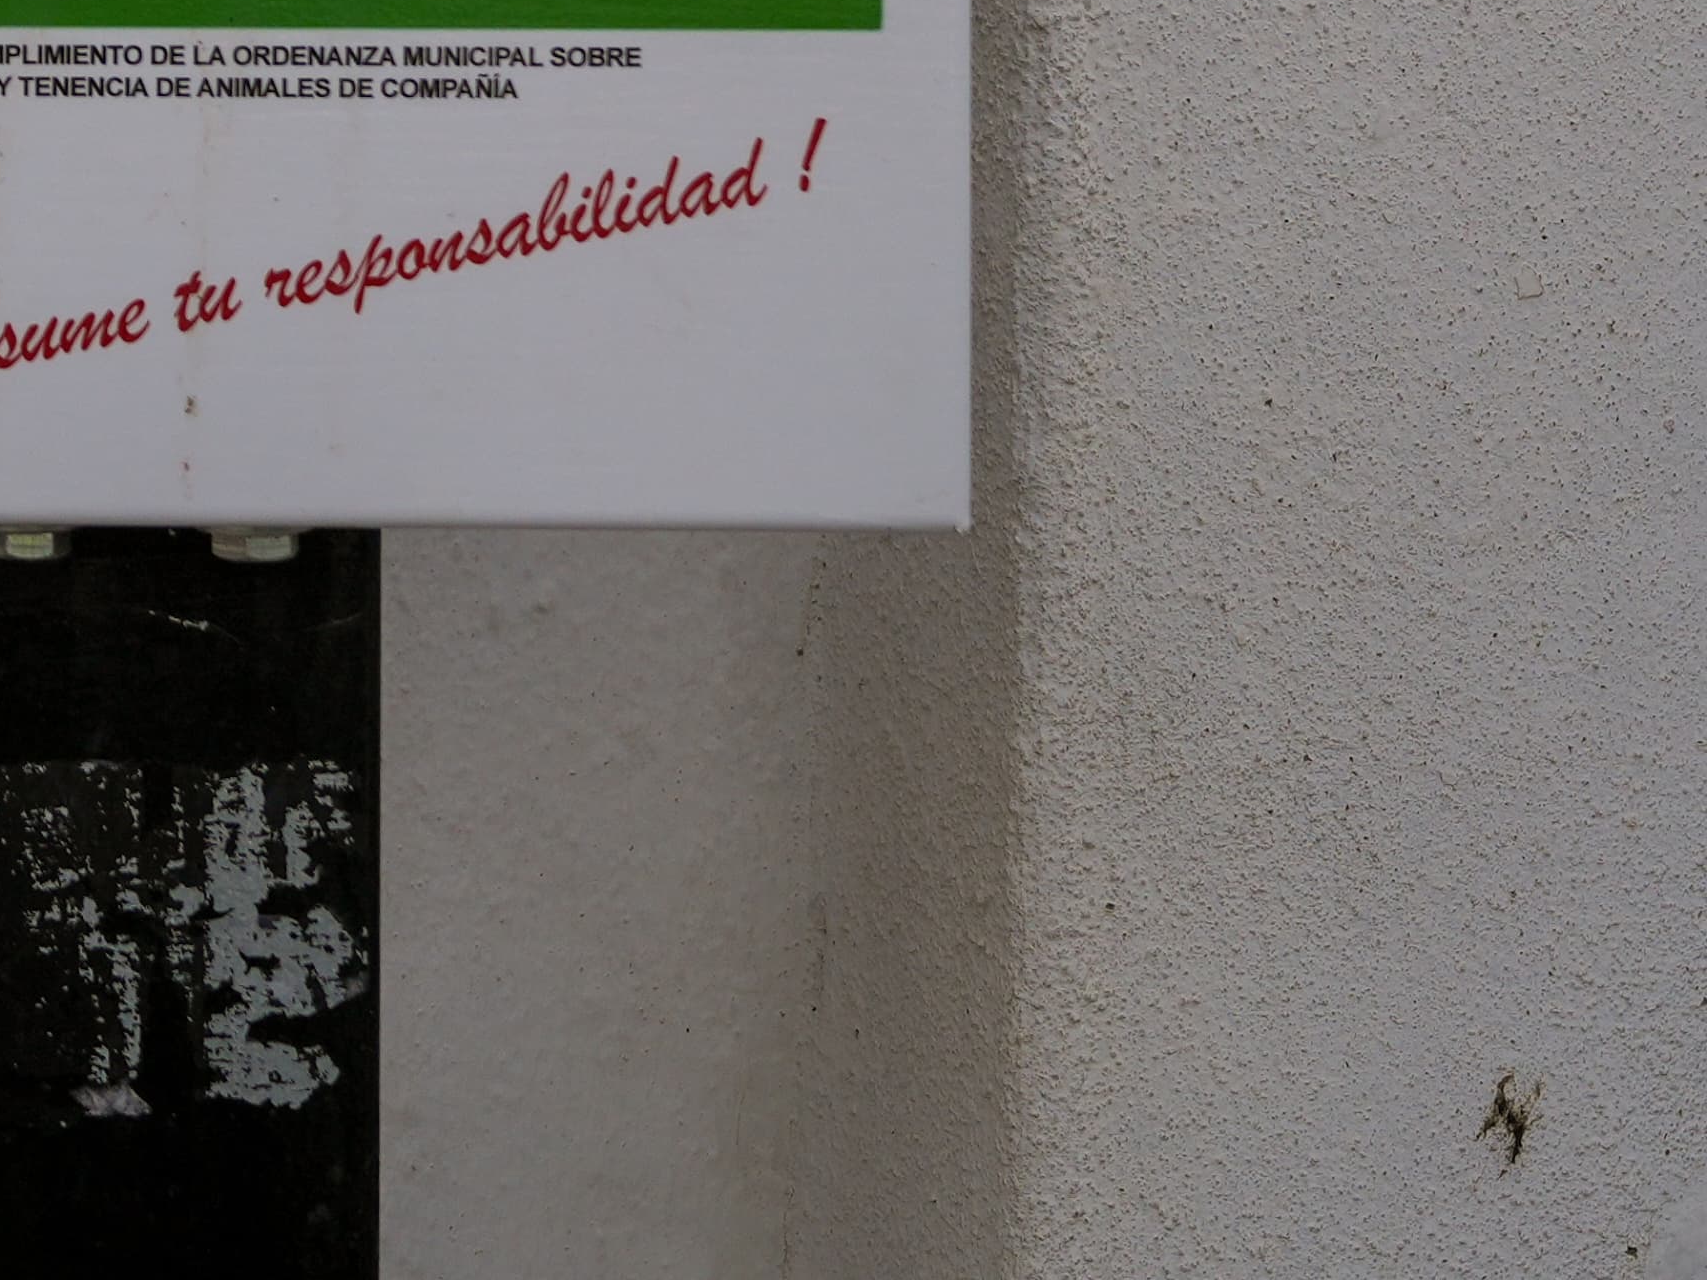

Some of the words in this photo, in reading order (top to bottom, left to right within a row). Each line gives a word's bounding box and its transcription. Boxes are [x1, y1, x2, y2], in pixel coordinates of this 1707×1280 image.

[150, 44, 186, 66] DE
[192, 44, 227, 67] LA
[232, 44, 398, 68] ORDENANZA
[402, 45, 545, 68] MUNICIPAL
[549, 46, 642, 68] SOBRE
[17, 75, 150, 98] TENENCIA
[155, 76, 191, 99] DE
[195, 77, 332, 99] ANIMALES
[338, 77, 375, 100] DE
[380, 72, 520, 100] COMPAÑÍA
[175, 272, 240, 333] tu
[265, 139, 767, 314] responsabilidad
